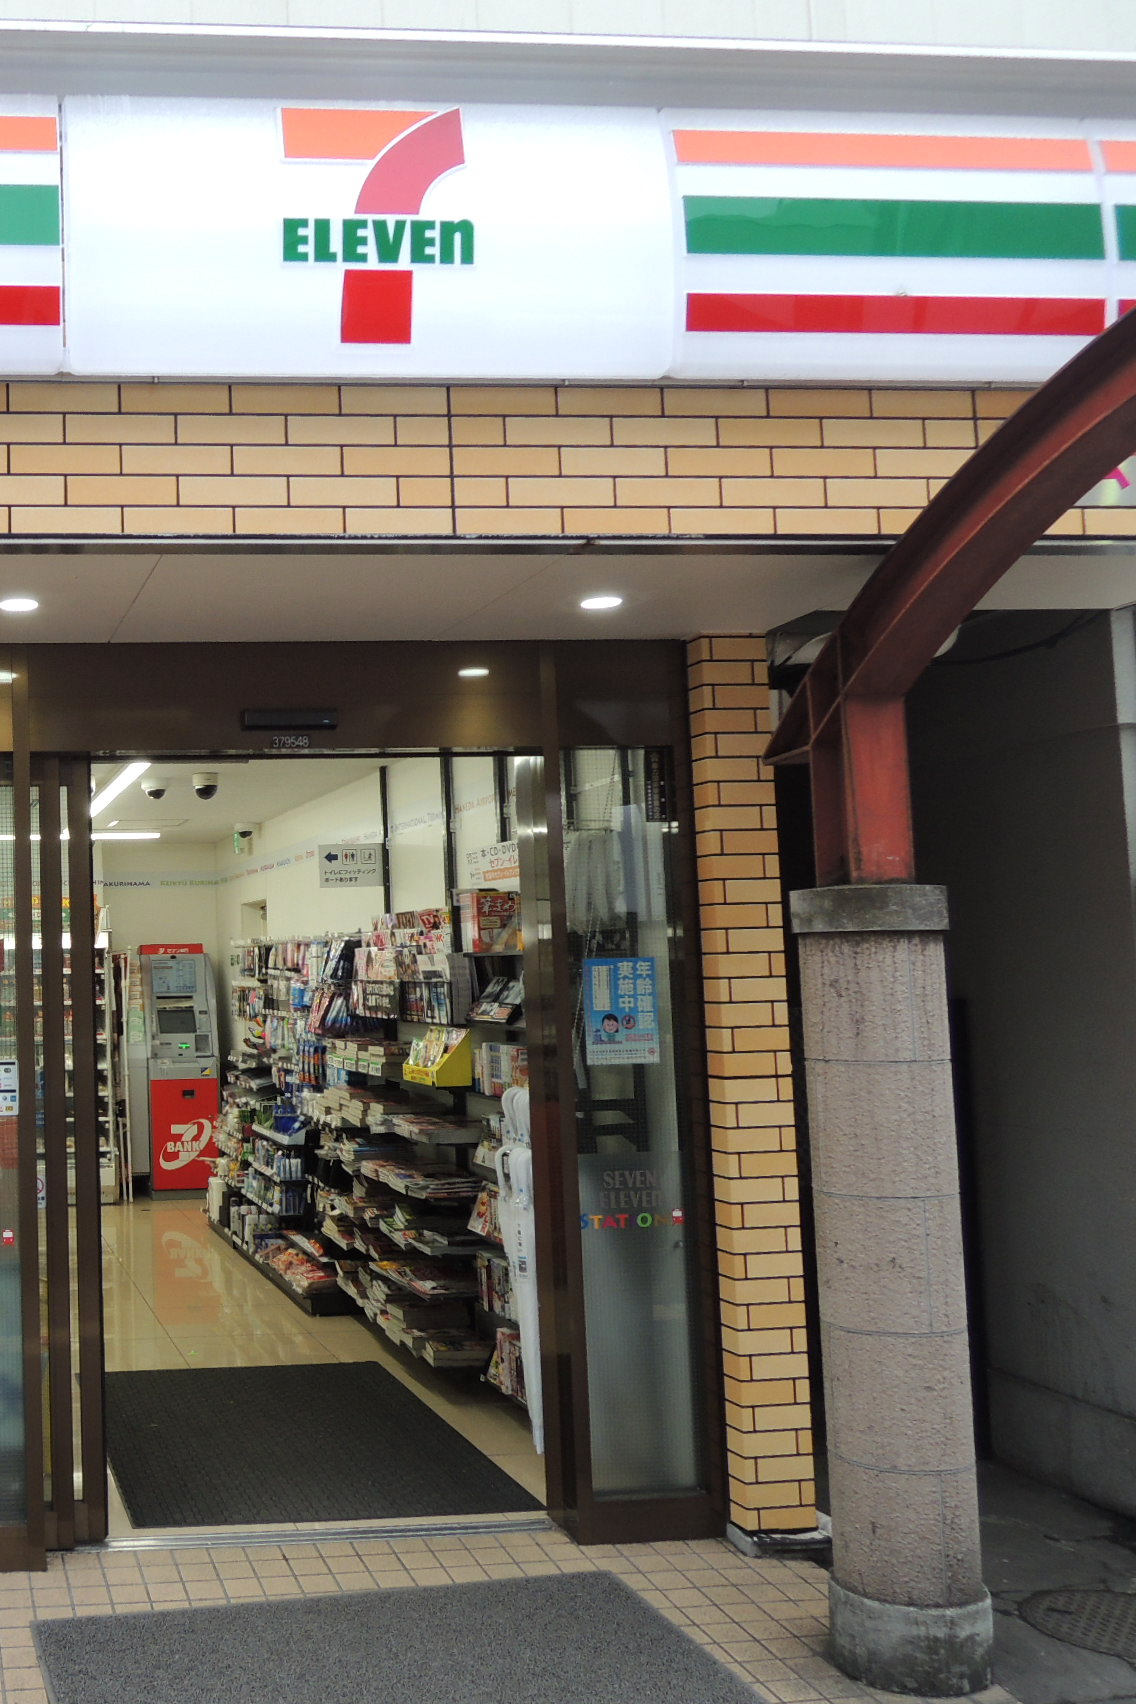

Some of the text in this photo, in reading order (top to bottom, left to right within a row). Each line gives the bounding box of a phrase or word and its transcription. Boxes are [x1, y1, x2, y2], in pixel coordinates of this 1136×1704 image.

[272, 736, 309, 748] 379548
[617, 961, 635, 1013] 実施中
[166, 1141, 201, 1153] BANK
[602, 1169, 660, 1189] SEVEN
[580, 1213, 670, 1230] STATION
